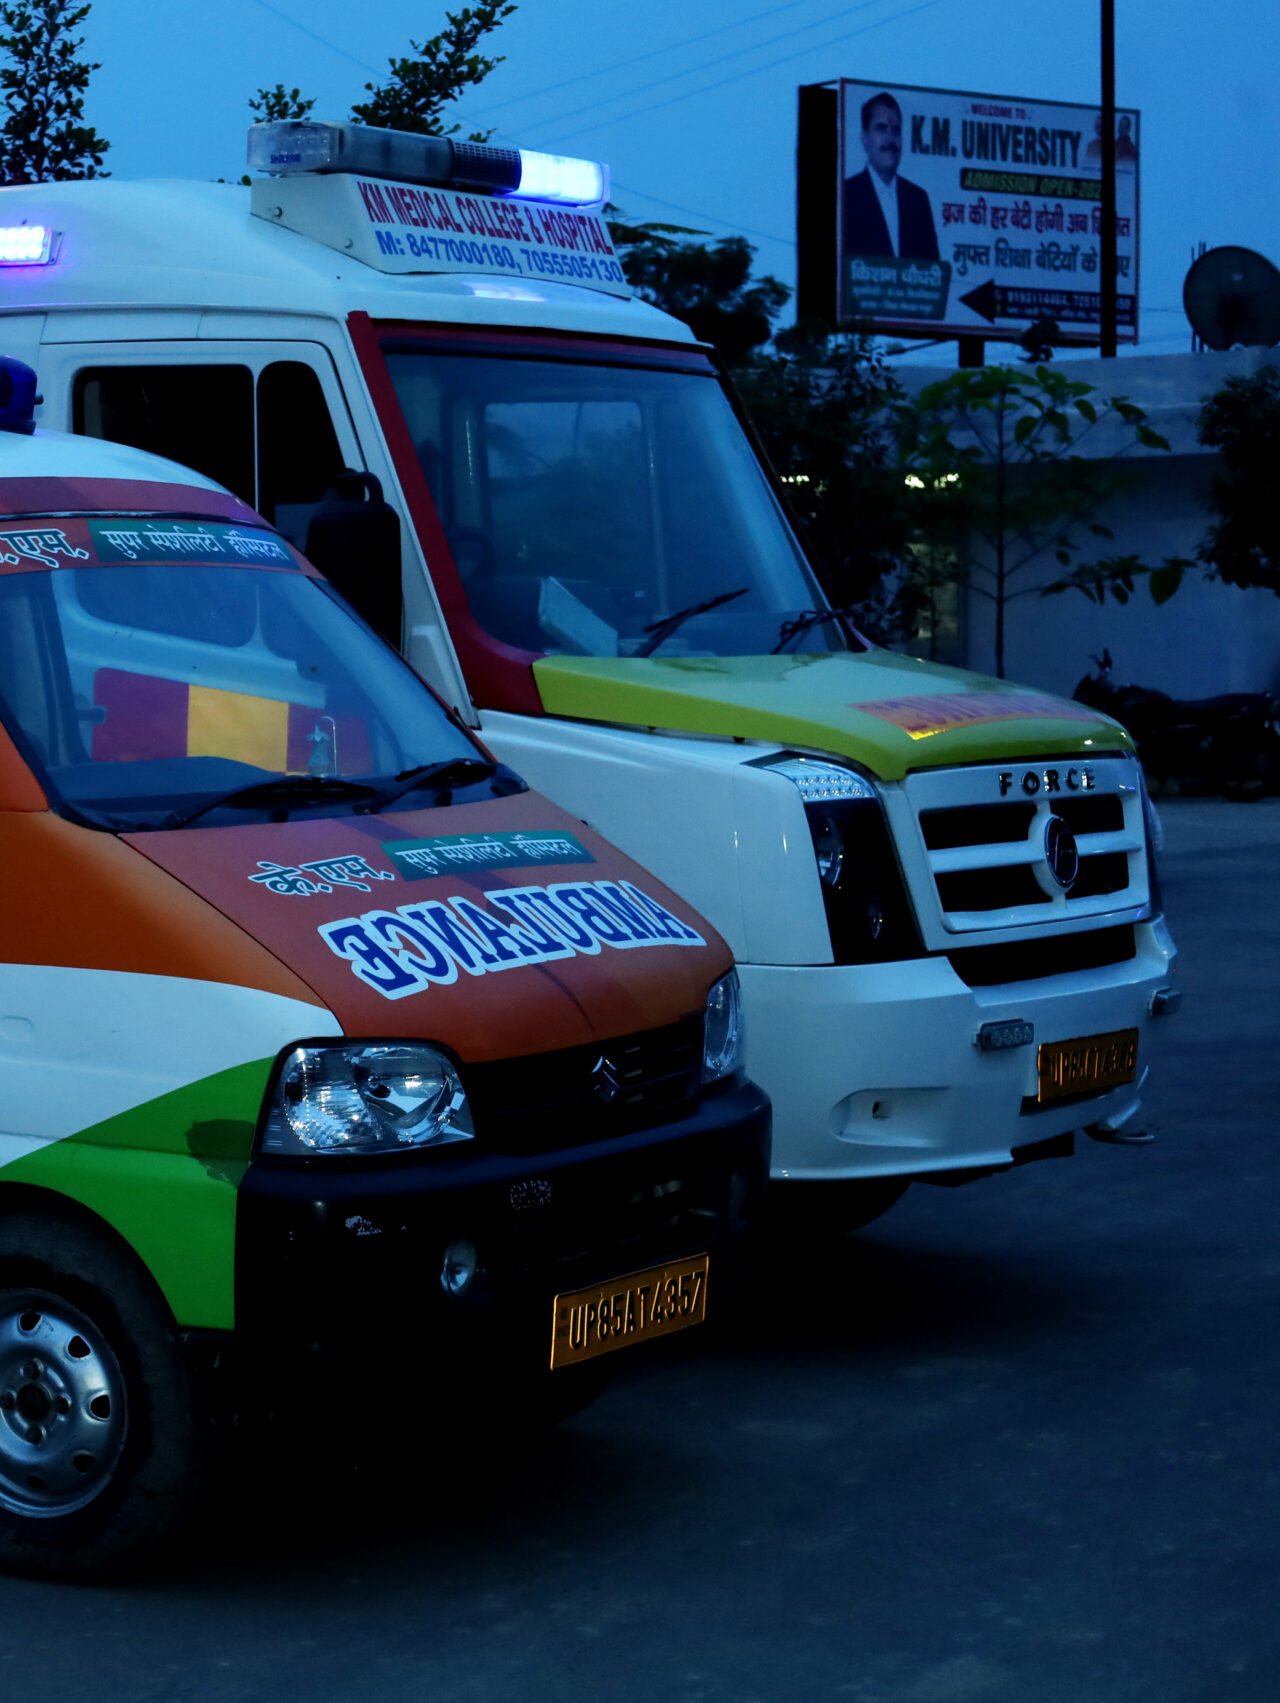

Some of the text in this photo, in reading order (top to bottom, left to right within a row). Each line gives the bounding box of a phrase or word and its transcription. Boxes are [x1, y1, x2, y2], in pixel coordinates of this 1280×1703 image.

[911, 115, 1082, 168] K.M. UNIVERSITY
[964, 170, 1102, 200] ADMISSION OPEN-202
[357, 182, 613, 255] KM MEDICAL COLLEGE & HOSPITAL
[969, 196, 987, 226] की
[991, 206, 1008, 230] हर
[1011, 200, 1032, 230] बेटी
[1035, 203, 1064, 233] होगी
[1067, 213, 1088, 234] अब
[375, 231, 623, 284] M: 8477000180, 7055505130
[994, 237, 1031, 269] शिक्षा
[1036, 241, 1079, 271] बेटियों
[1081, 246, 1099, 273] के
[100, 530, 150, 560] सुपर
[999, 767, 1096, 796] FORCE
[394, 847, 448, 876] सुपर
[569, 1271, 705, 1350] UP85AT4357
